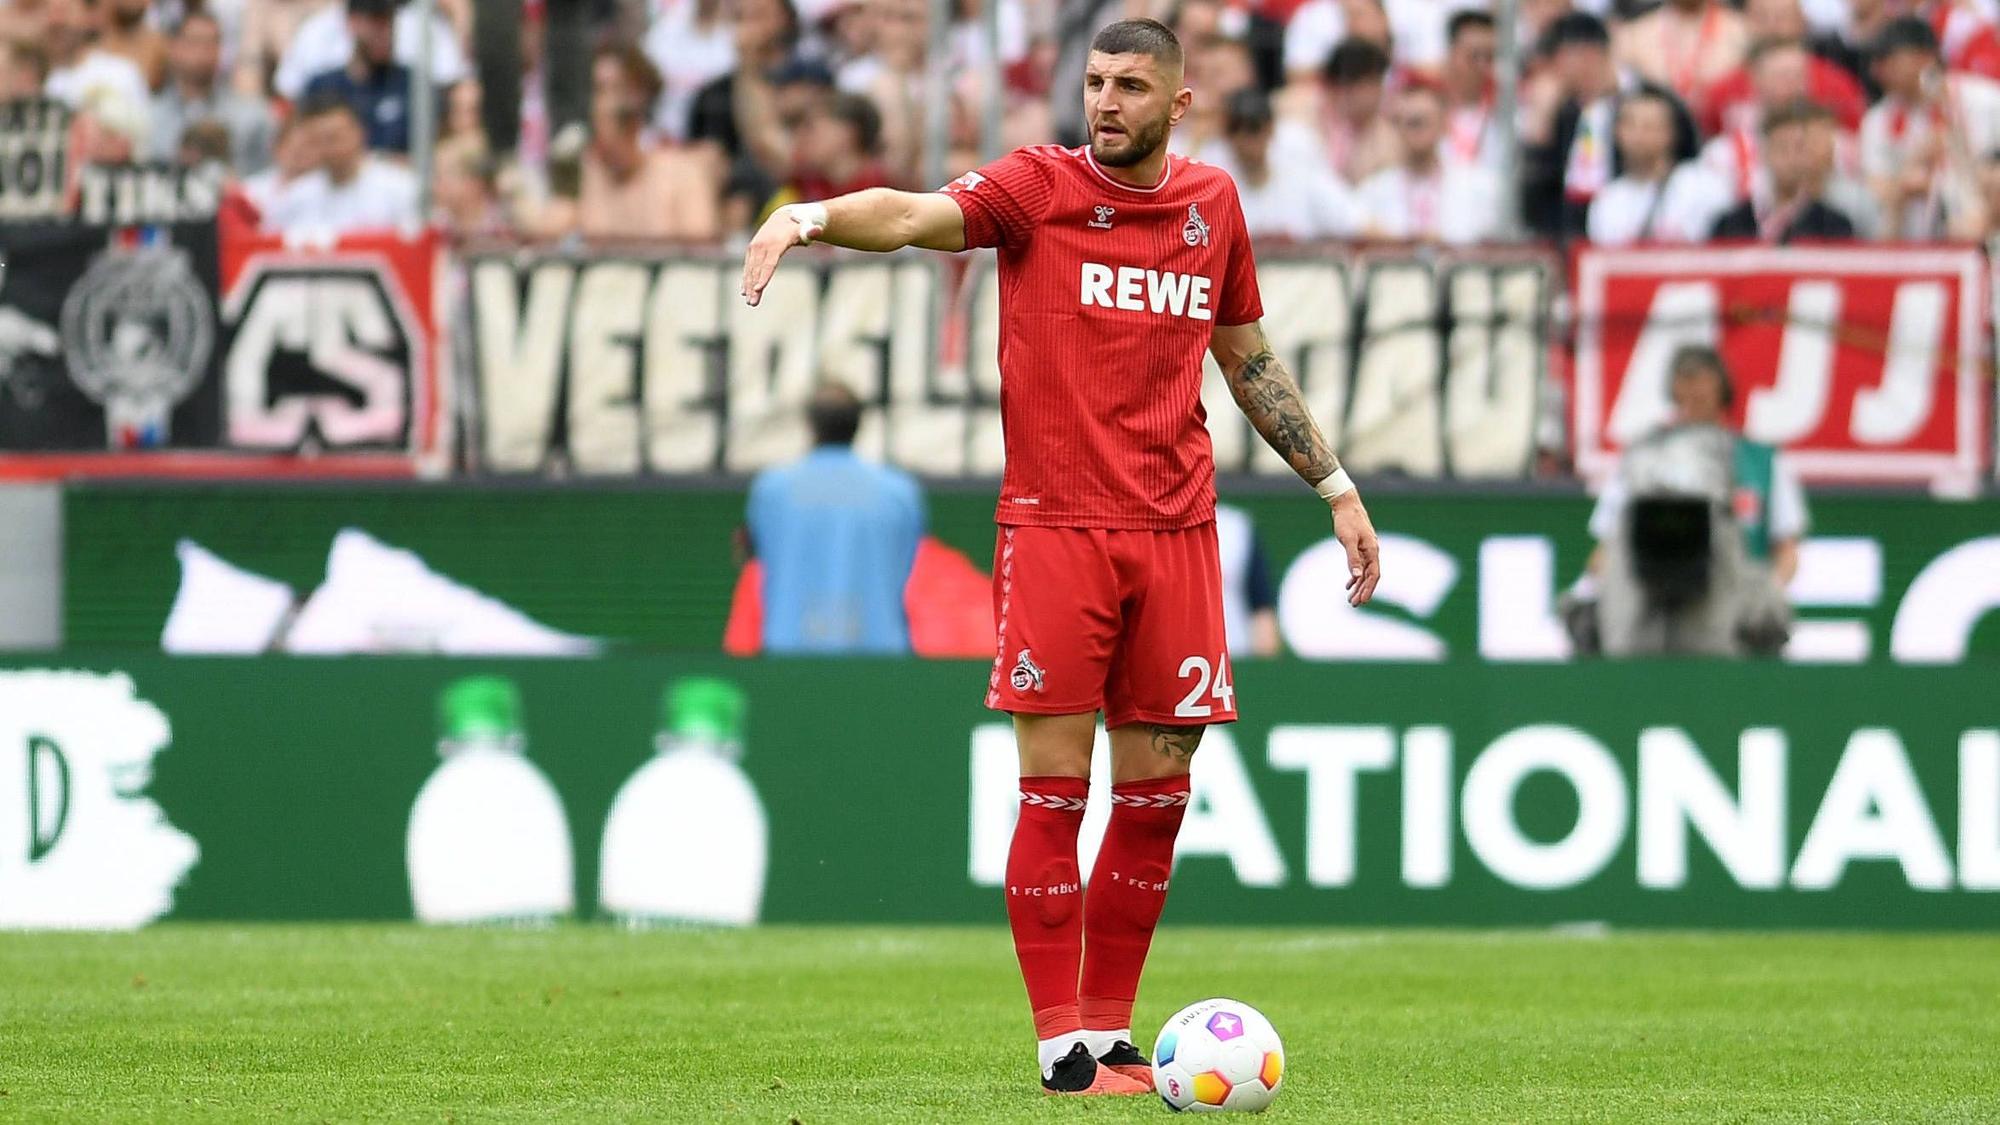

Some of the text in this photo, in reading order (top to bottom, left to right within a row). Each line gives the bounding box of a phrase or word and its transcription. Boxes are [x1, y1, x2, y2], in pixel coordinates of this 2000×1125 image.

[1080, 261, 1212, 321] REWE
[1174, 652, 1234, 718] 24
[1024, 887, 1043, 897] FC
[1128, 878, 1149, 890] FC
